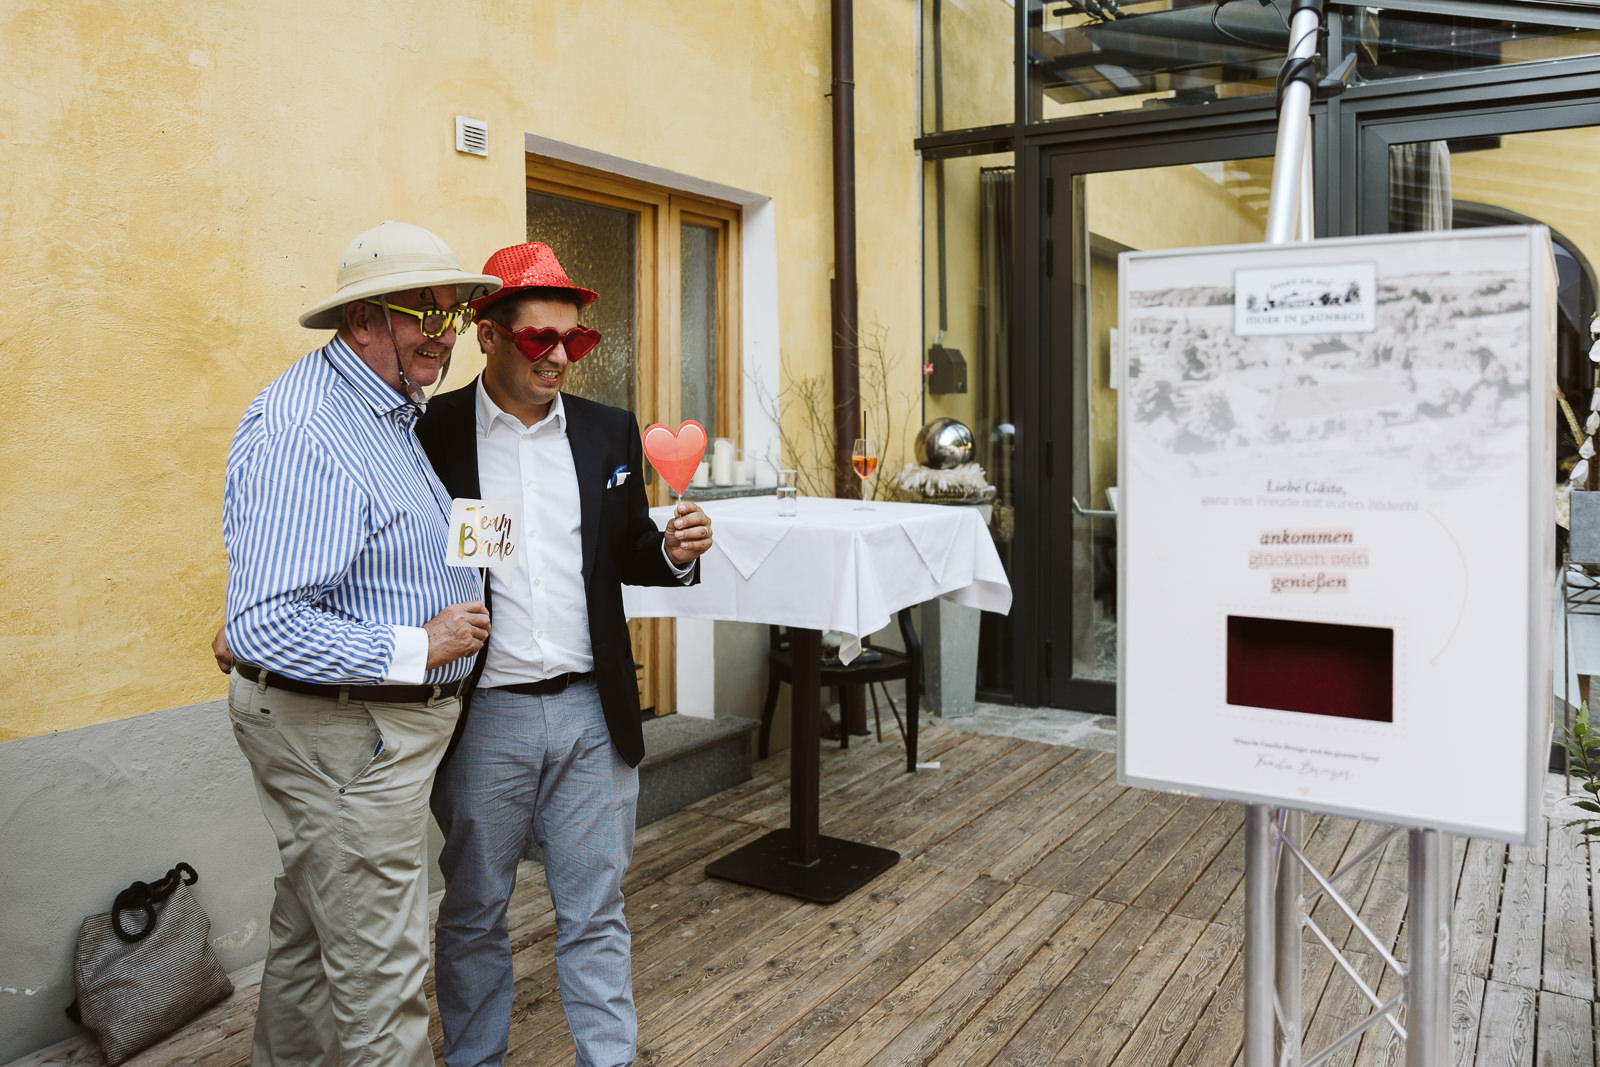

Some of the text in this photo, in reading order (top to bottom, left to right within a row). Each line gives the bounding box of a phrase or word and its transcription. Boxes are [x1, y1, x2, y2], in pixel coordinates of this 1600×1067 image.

[1267, 480, 1301, 494] Liebe
[1256, 496, 1299, 508] Freude
[1302, 497, 1322, 508] mit
[466, 506, 511, 539] Team
[458, 522, 514, 561] Bride
[1260, 530, 1353, 544] ankommen
[1249, 552, 1368, 569] glücklich sein
[1272, 572, 1347, 593] genießen
